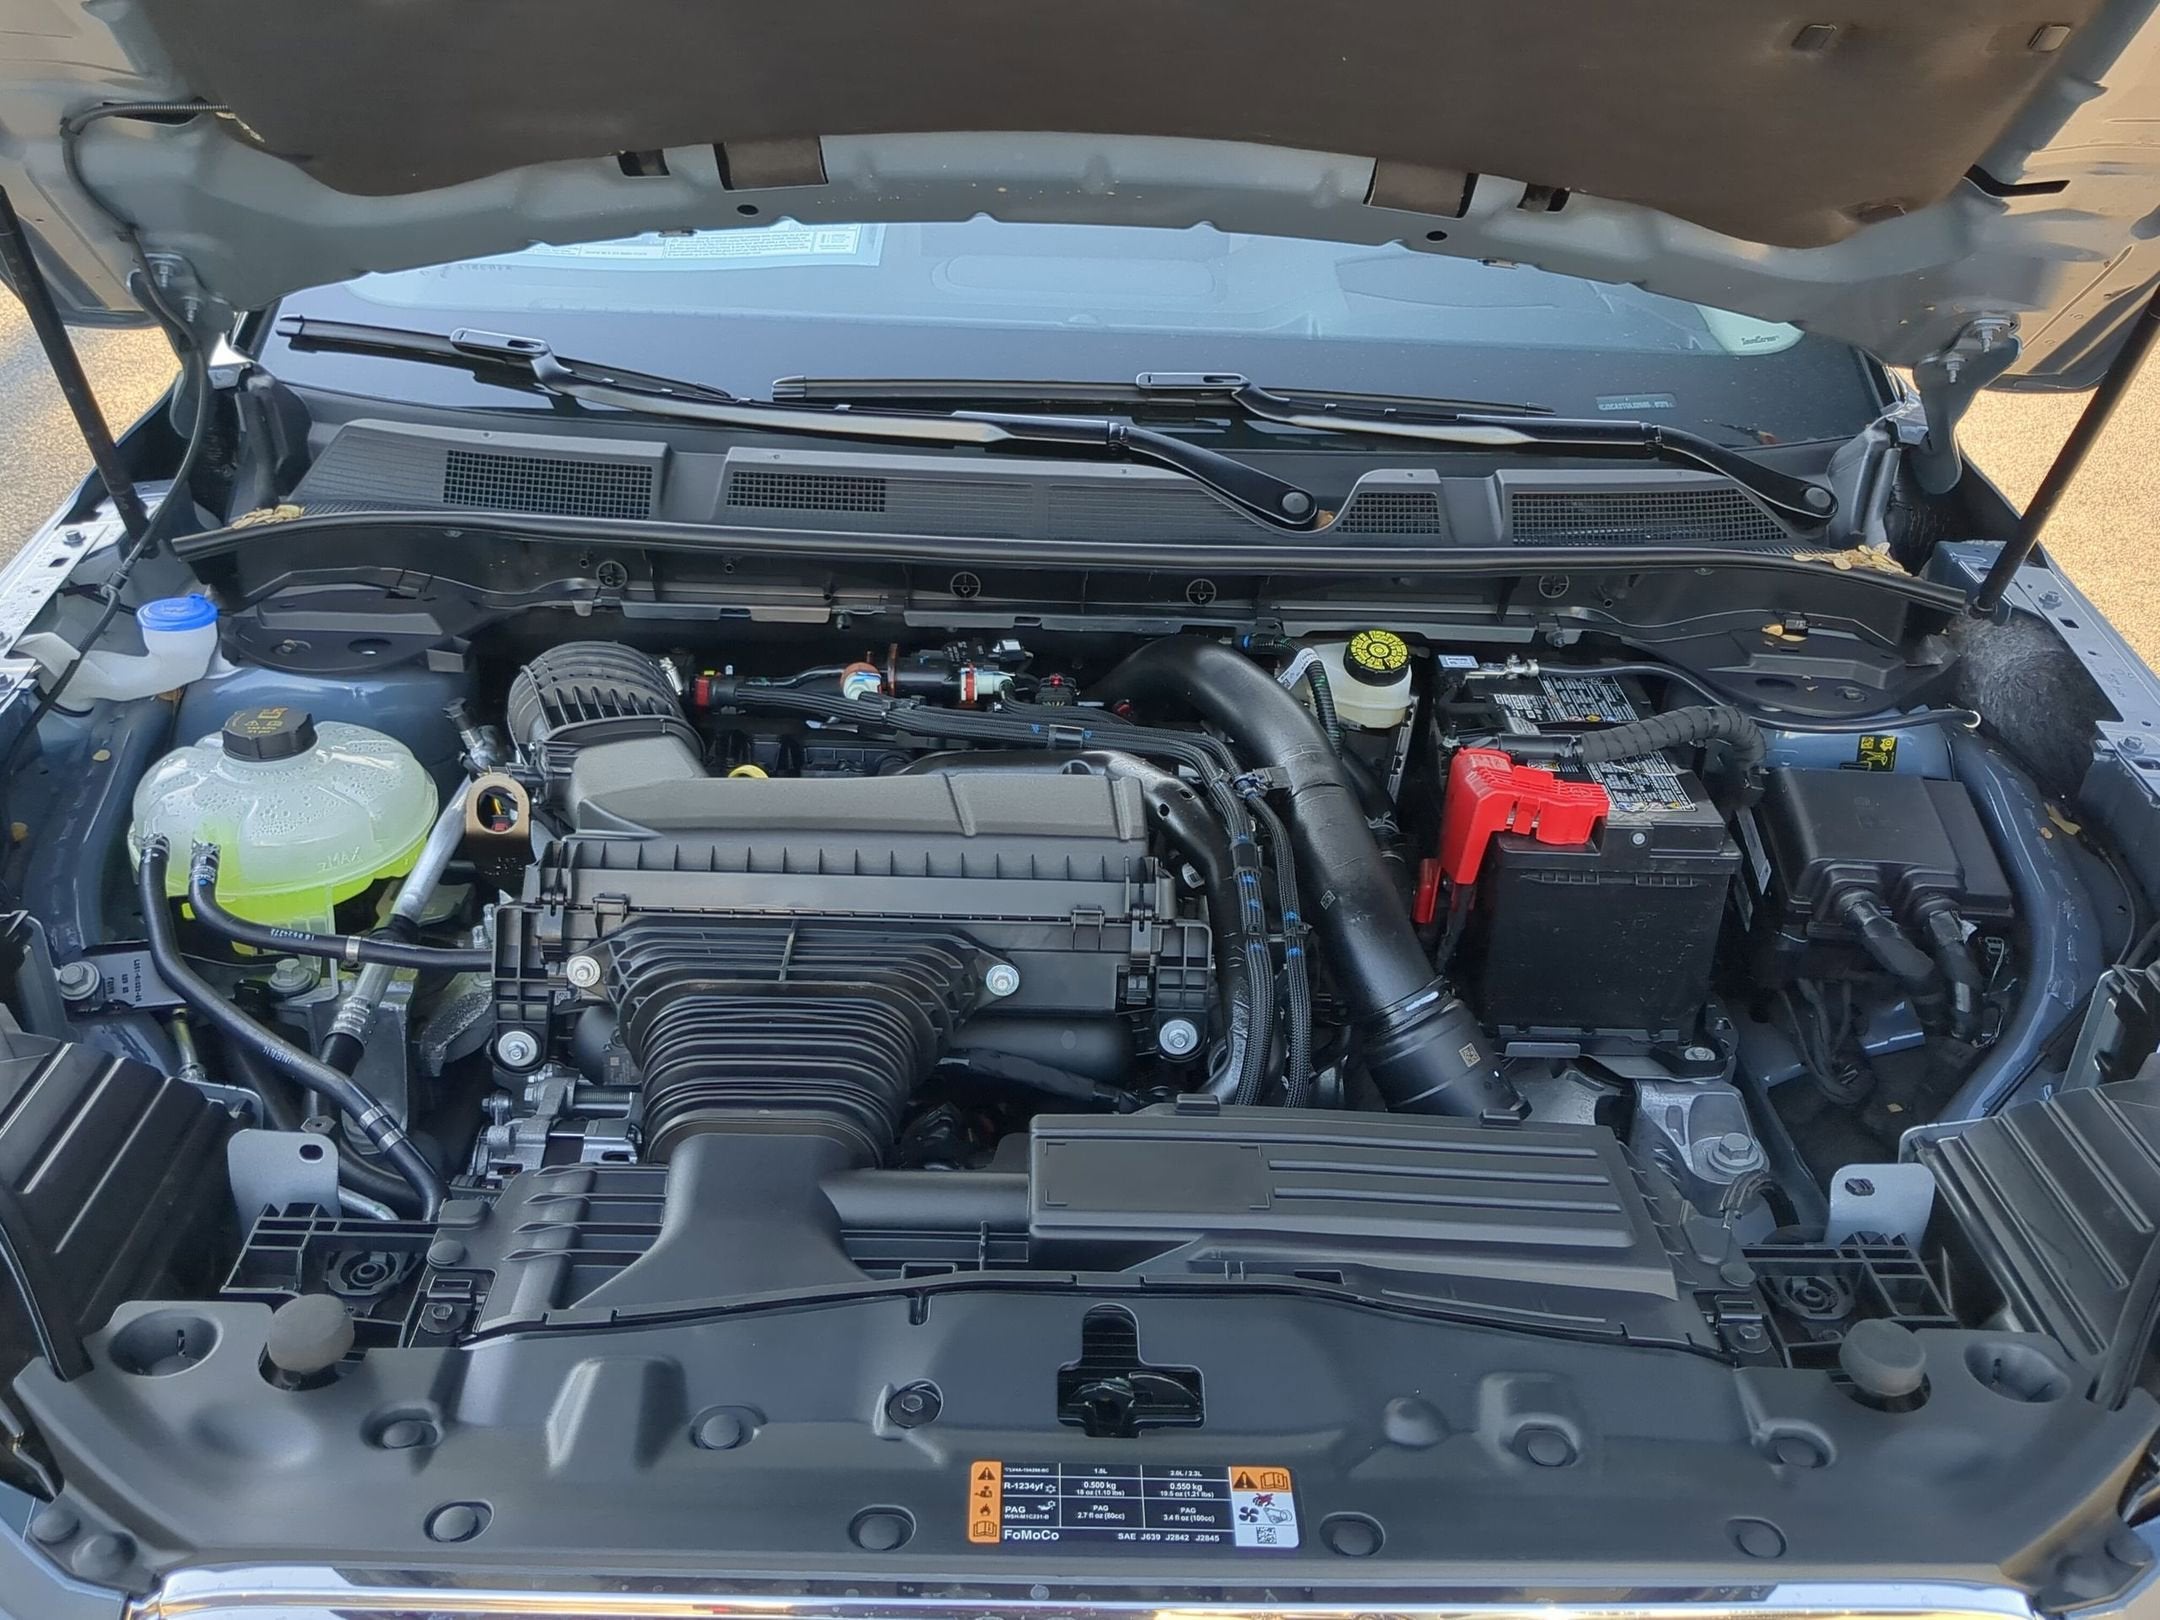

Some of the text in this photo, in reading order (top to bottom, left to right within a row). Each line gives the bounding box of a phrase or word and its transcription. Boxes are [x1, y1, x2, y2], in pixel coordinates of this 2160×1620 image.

[1003, 1481, 1044, 1492] R-1234yf
[1083, 1481, 1117, 1490] 0.500 kg
[1170, 1482, 1203, 1492] 0.550 kg
[1004, 1505, 1027, 1514] PAG
[1092, 1504, 1110, 1512] PAG
[1180, 1506, 1197, 1514] PAG
[1077, 1511, 1088, 1519] 2.7
[1163, 1513, 1175, 1521] 3.4
[1004, 1529, 1060, 1541] FoMoCo
[1117, 1532, 1220, 1542] SAE J639 J2842 J2845
